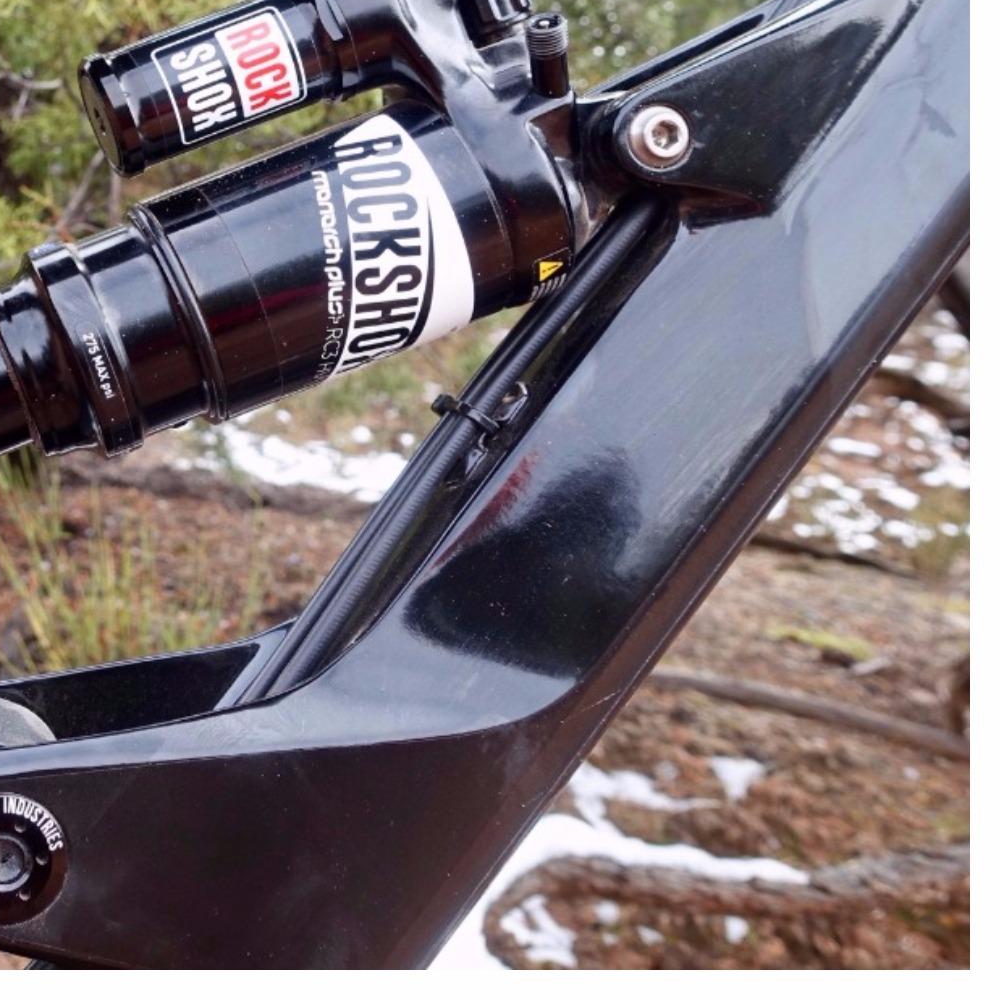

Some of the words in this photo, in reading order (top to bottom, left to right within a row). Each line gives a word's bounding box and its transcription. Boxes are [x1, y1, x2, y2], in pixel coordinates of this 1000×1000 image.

[170, 42, 237, 133] SHOX
[225, 21, 293, 111] ROCK
[311, 169, 344, 264] monarch
[82, 331, 101, 355] 275
[90, 355, 112, 382] MAX
[2, 796, 64, 853] INDUSTRIES
